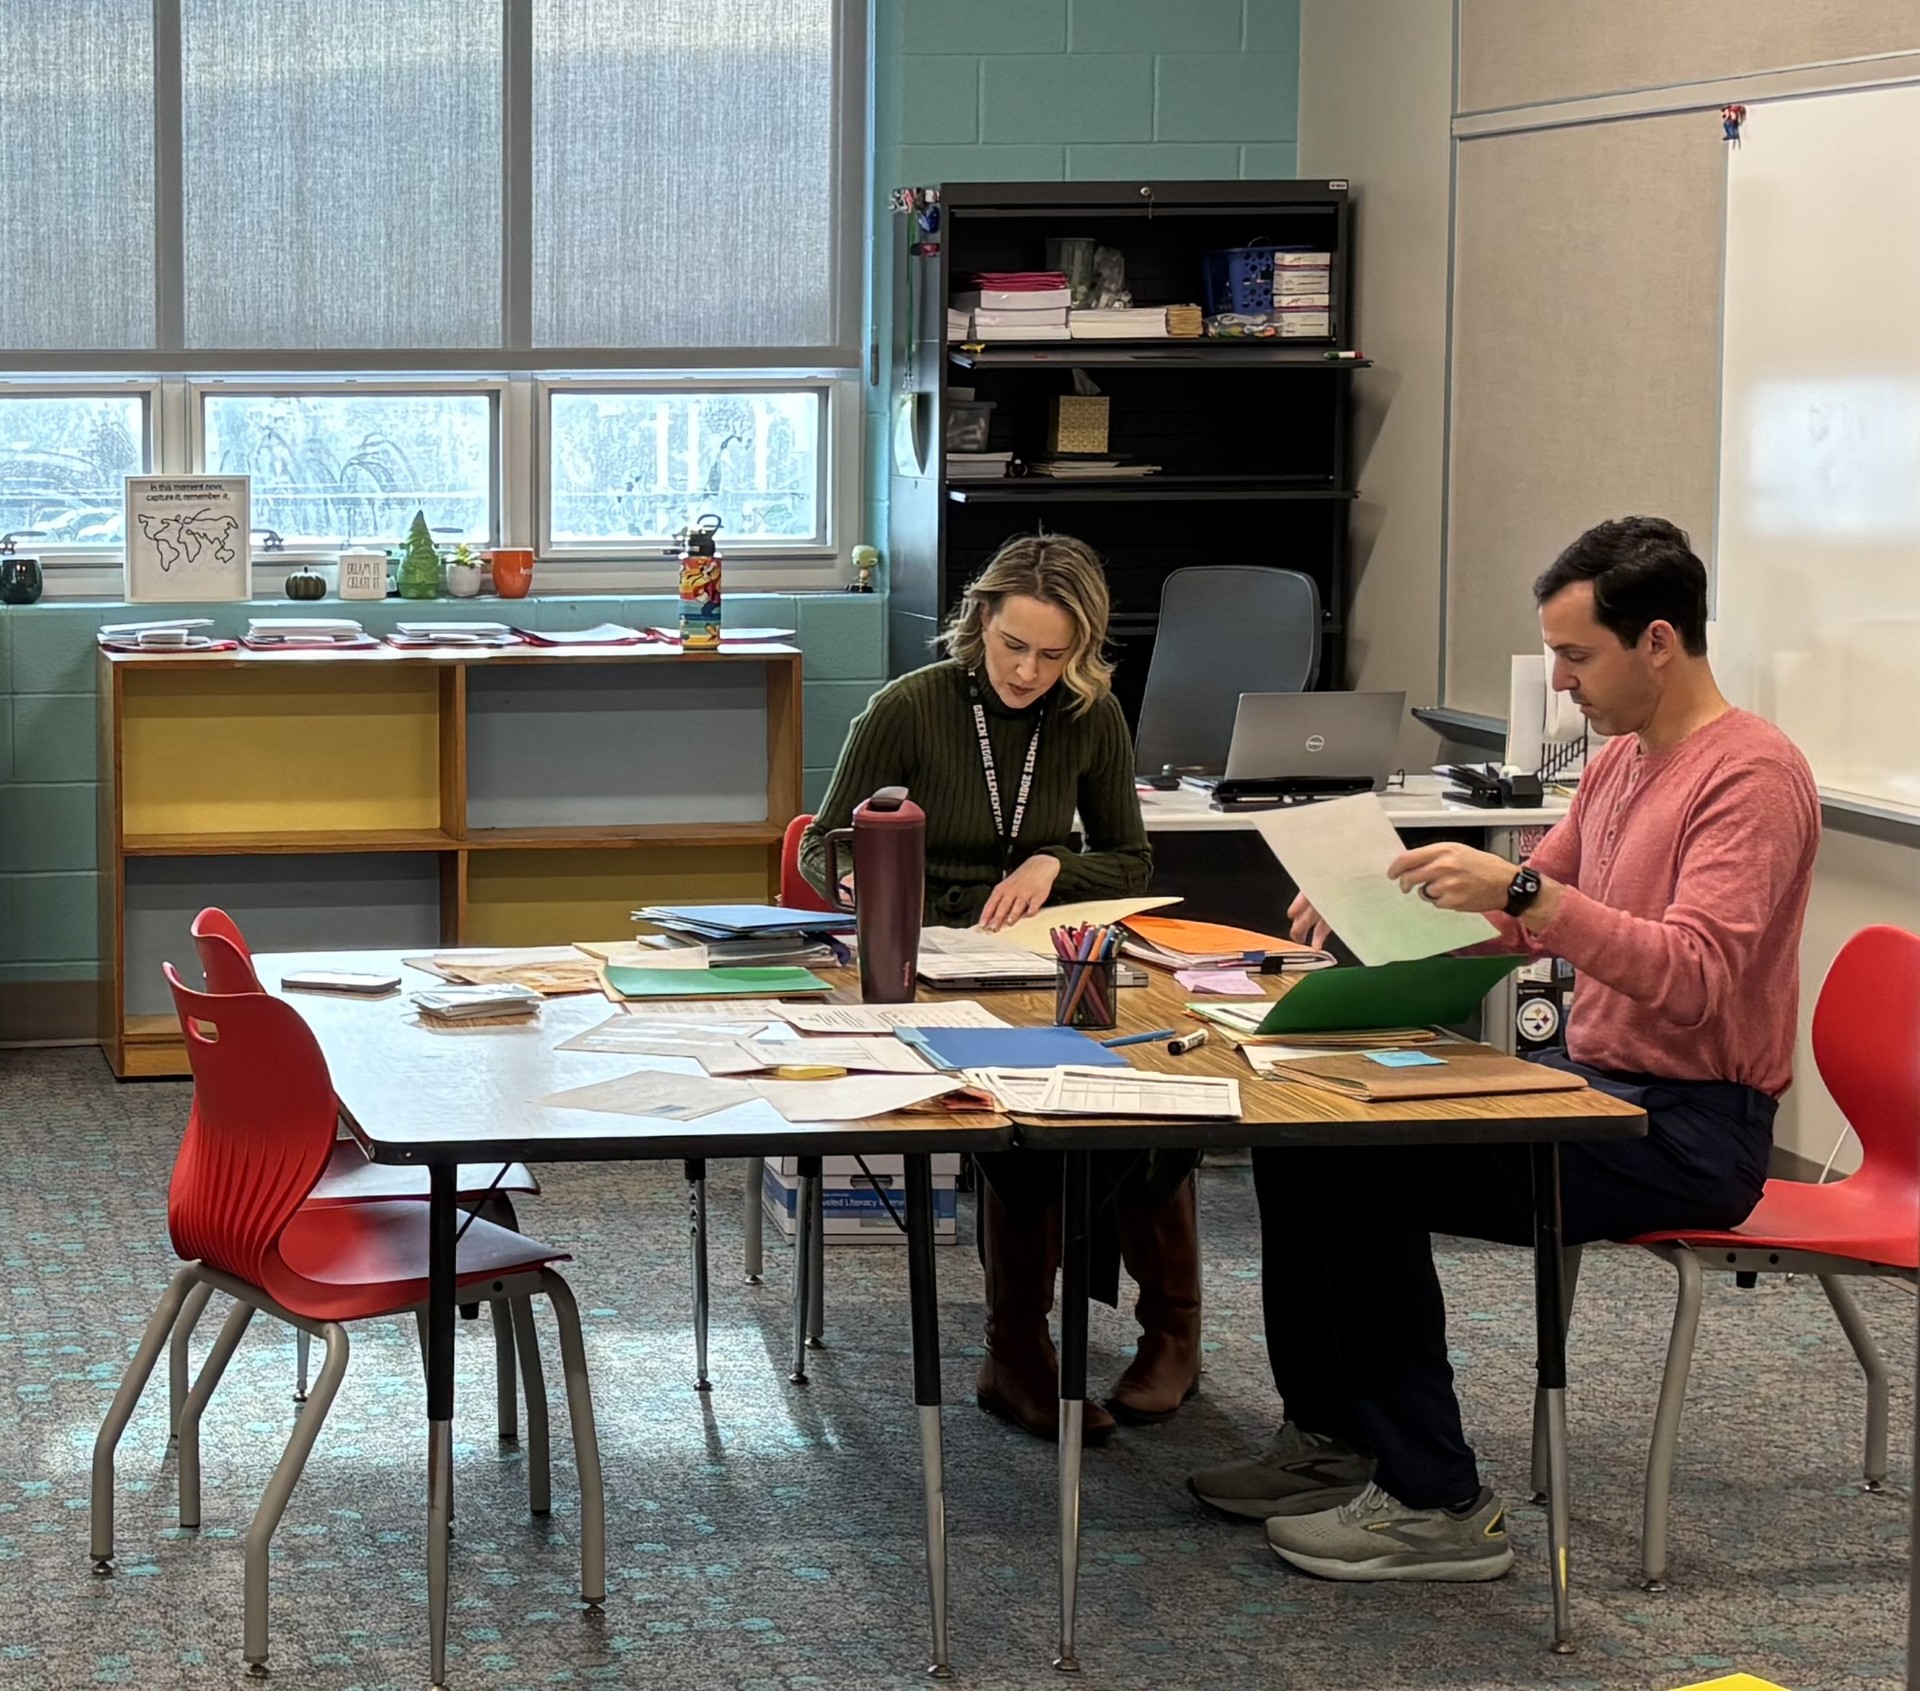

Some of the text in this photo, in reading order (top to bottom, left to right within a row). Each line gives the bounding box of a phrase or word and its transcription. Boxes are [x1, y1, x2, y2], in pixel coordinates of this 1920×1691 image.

[146, 494, 174, 502] capture
[183, 492, 220, 501] remember
[159, 483, 172, 491] this
[973, 704, 1004, 835] GREEN RIDGE ELEMENTARY
[1017, 774, 1032, 804] RIDGE
[1010, 805, 1025, 837] GREEN
[845, 1198, 877, 1207] Literacy
